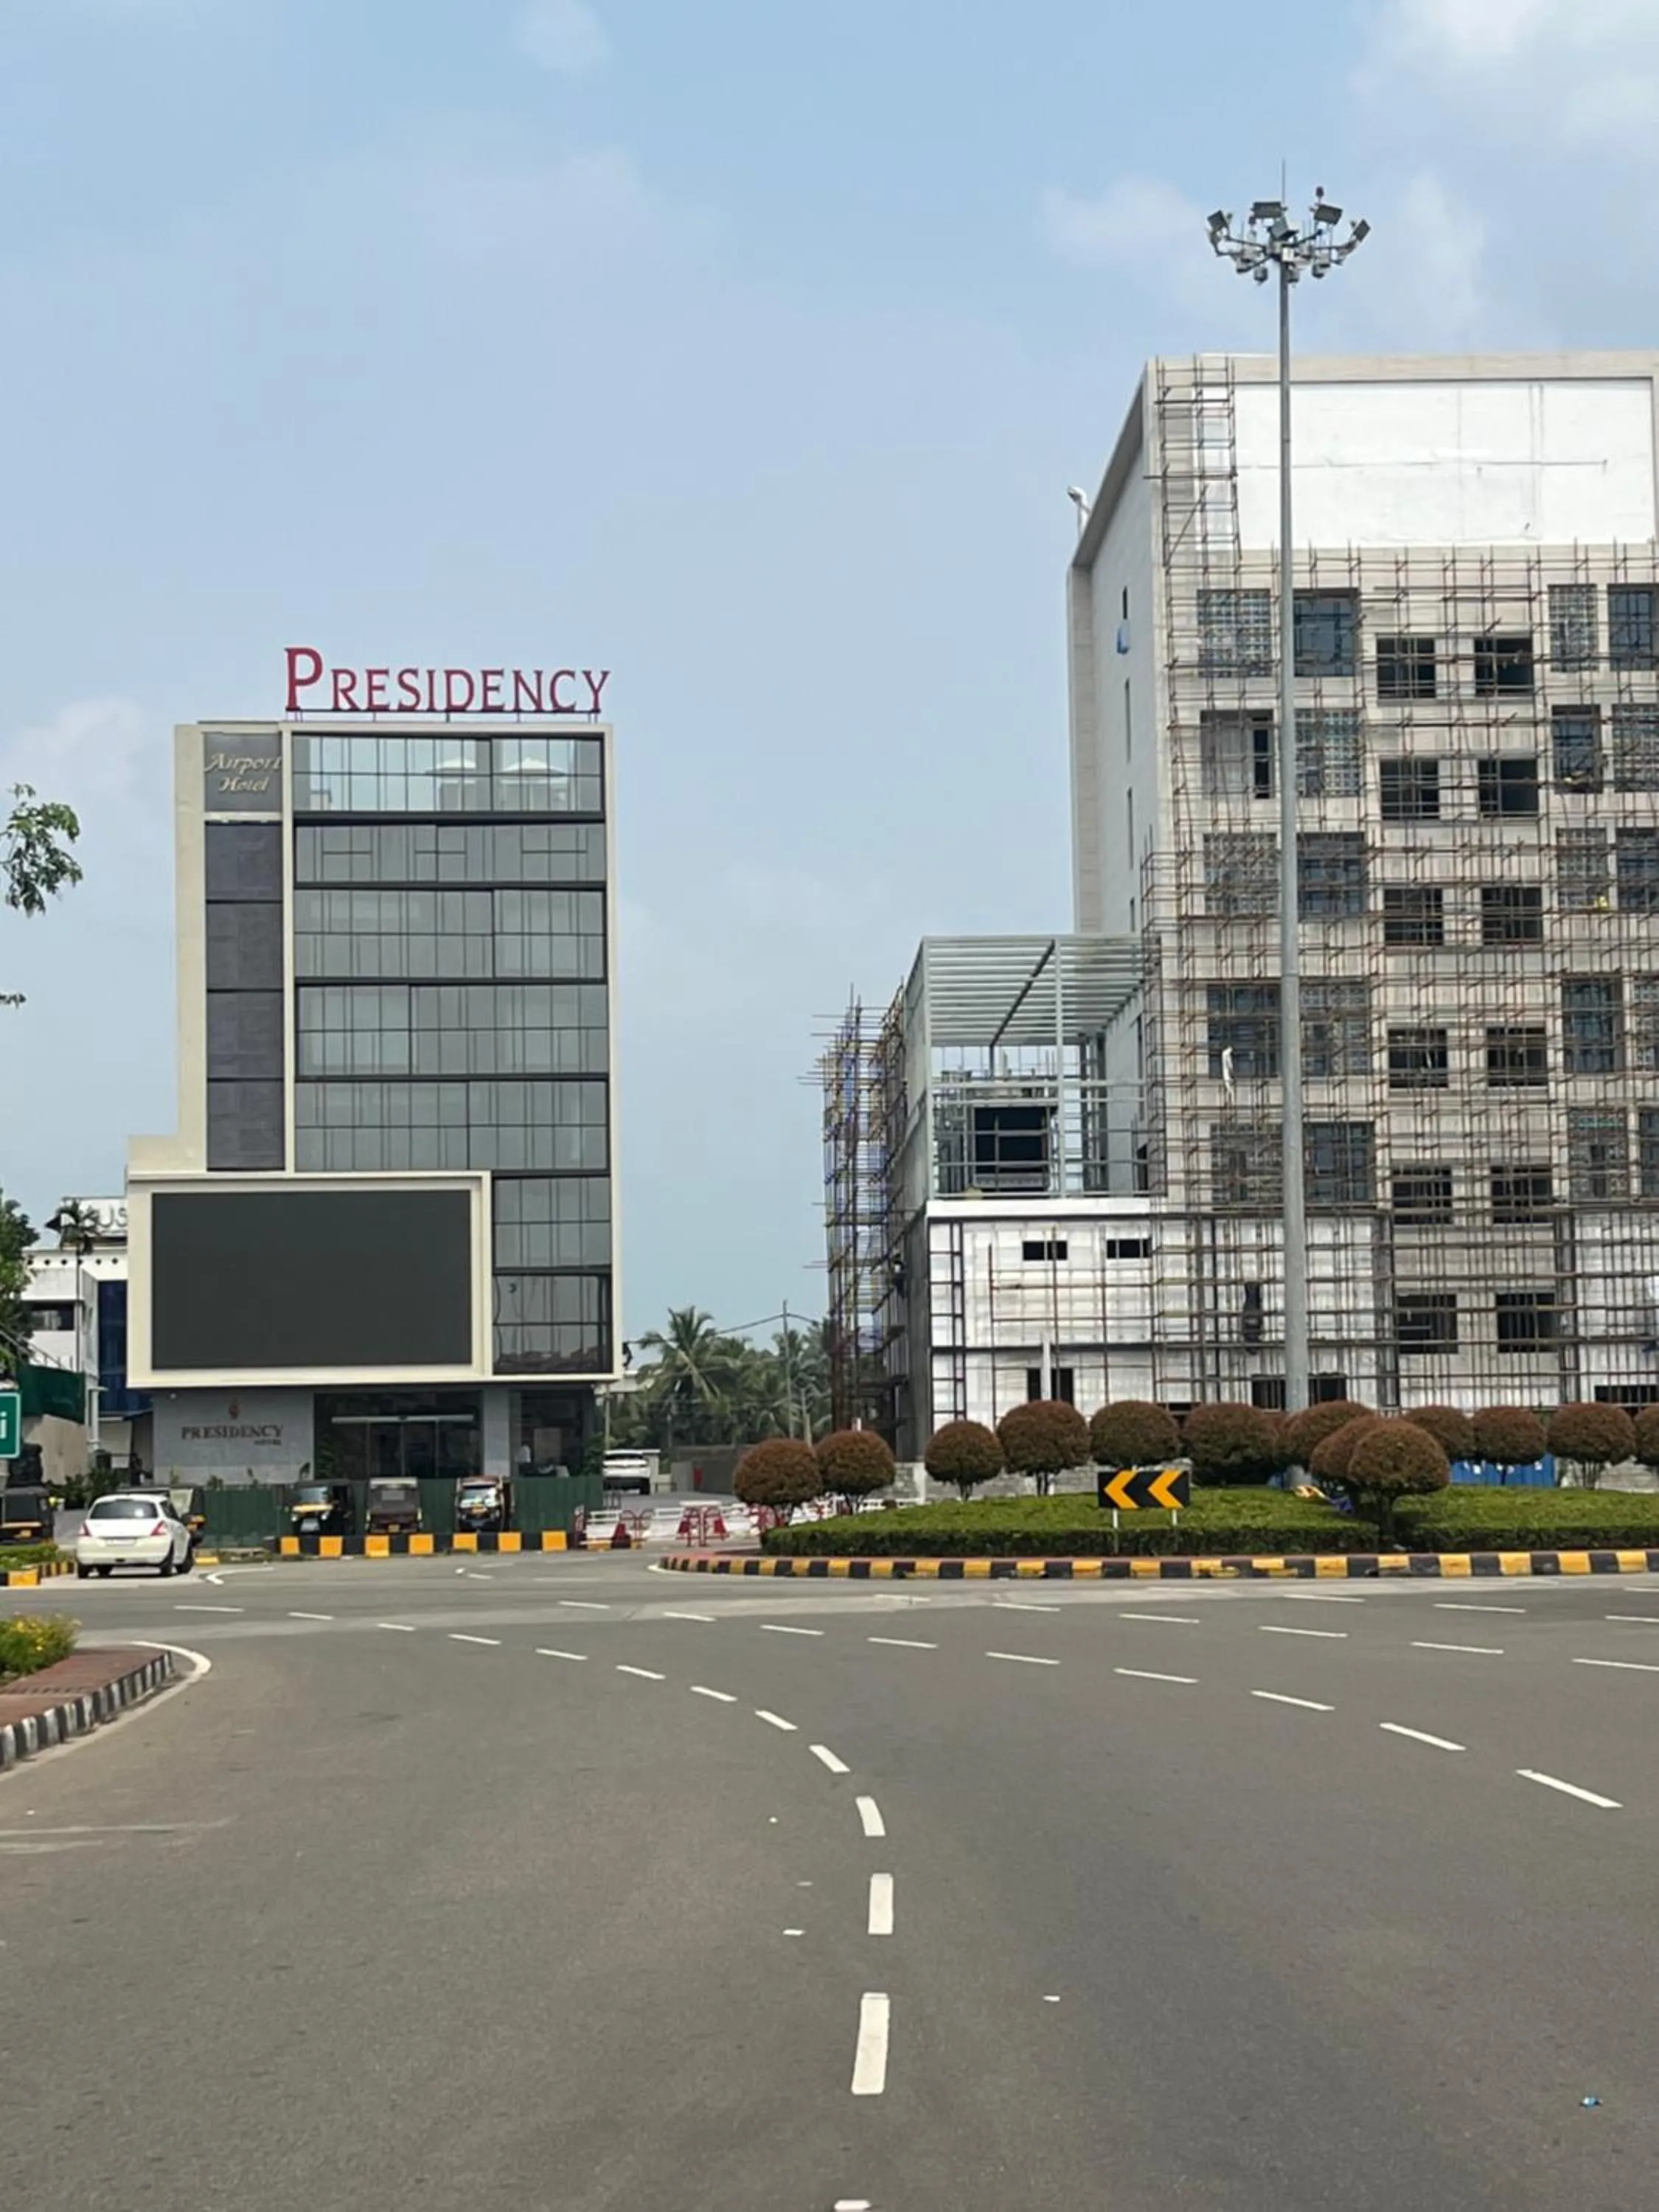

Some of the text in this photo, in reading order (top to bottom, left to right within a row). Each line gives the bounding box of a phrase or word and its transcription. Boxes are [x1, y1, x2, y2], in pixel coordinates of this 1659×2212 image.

[285, 647, 611, 712] PRESIDENCY
[204, 753, 283, 775] Airport
[218, 776, 270, 791] Hotel
[181, 1424, 284, 1439] PRESIDENCY
